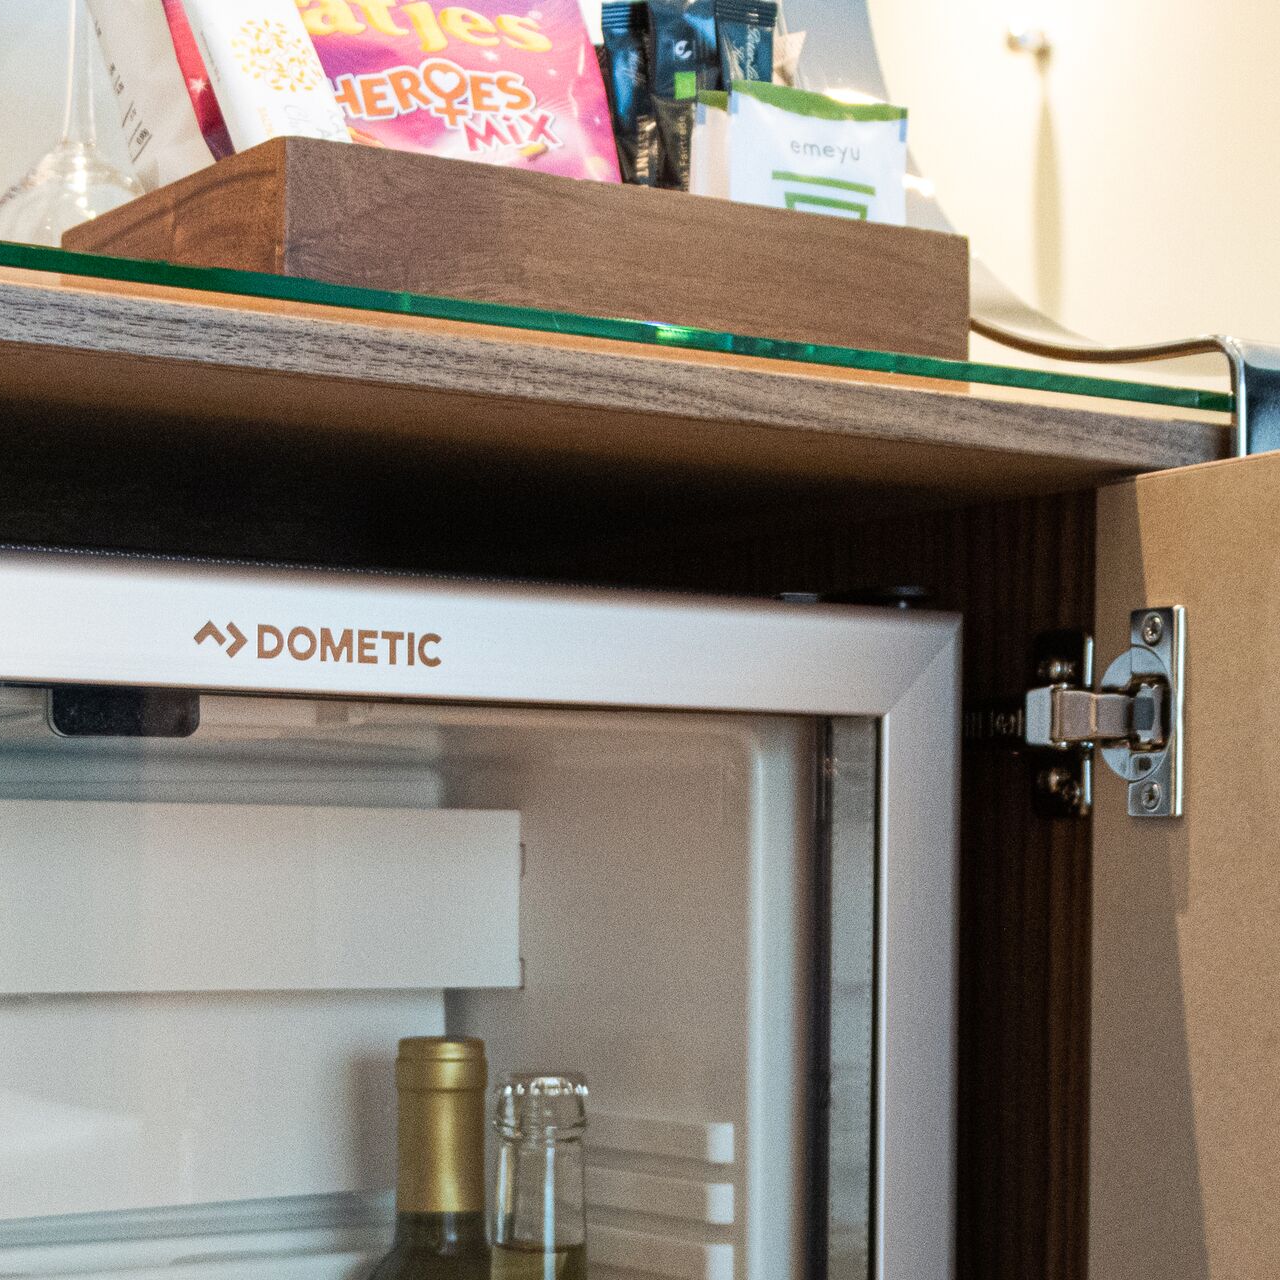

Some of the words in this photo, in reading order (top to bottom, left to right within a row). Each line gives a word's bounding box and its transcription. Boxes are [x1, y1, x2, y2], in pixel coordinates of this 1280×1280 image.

[302, 0, 553, 52] atjes
[790, 138, 861, 164] emeyu
[256, 623, 443, 668] DOMETIC
